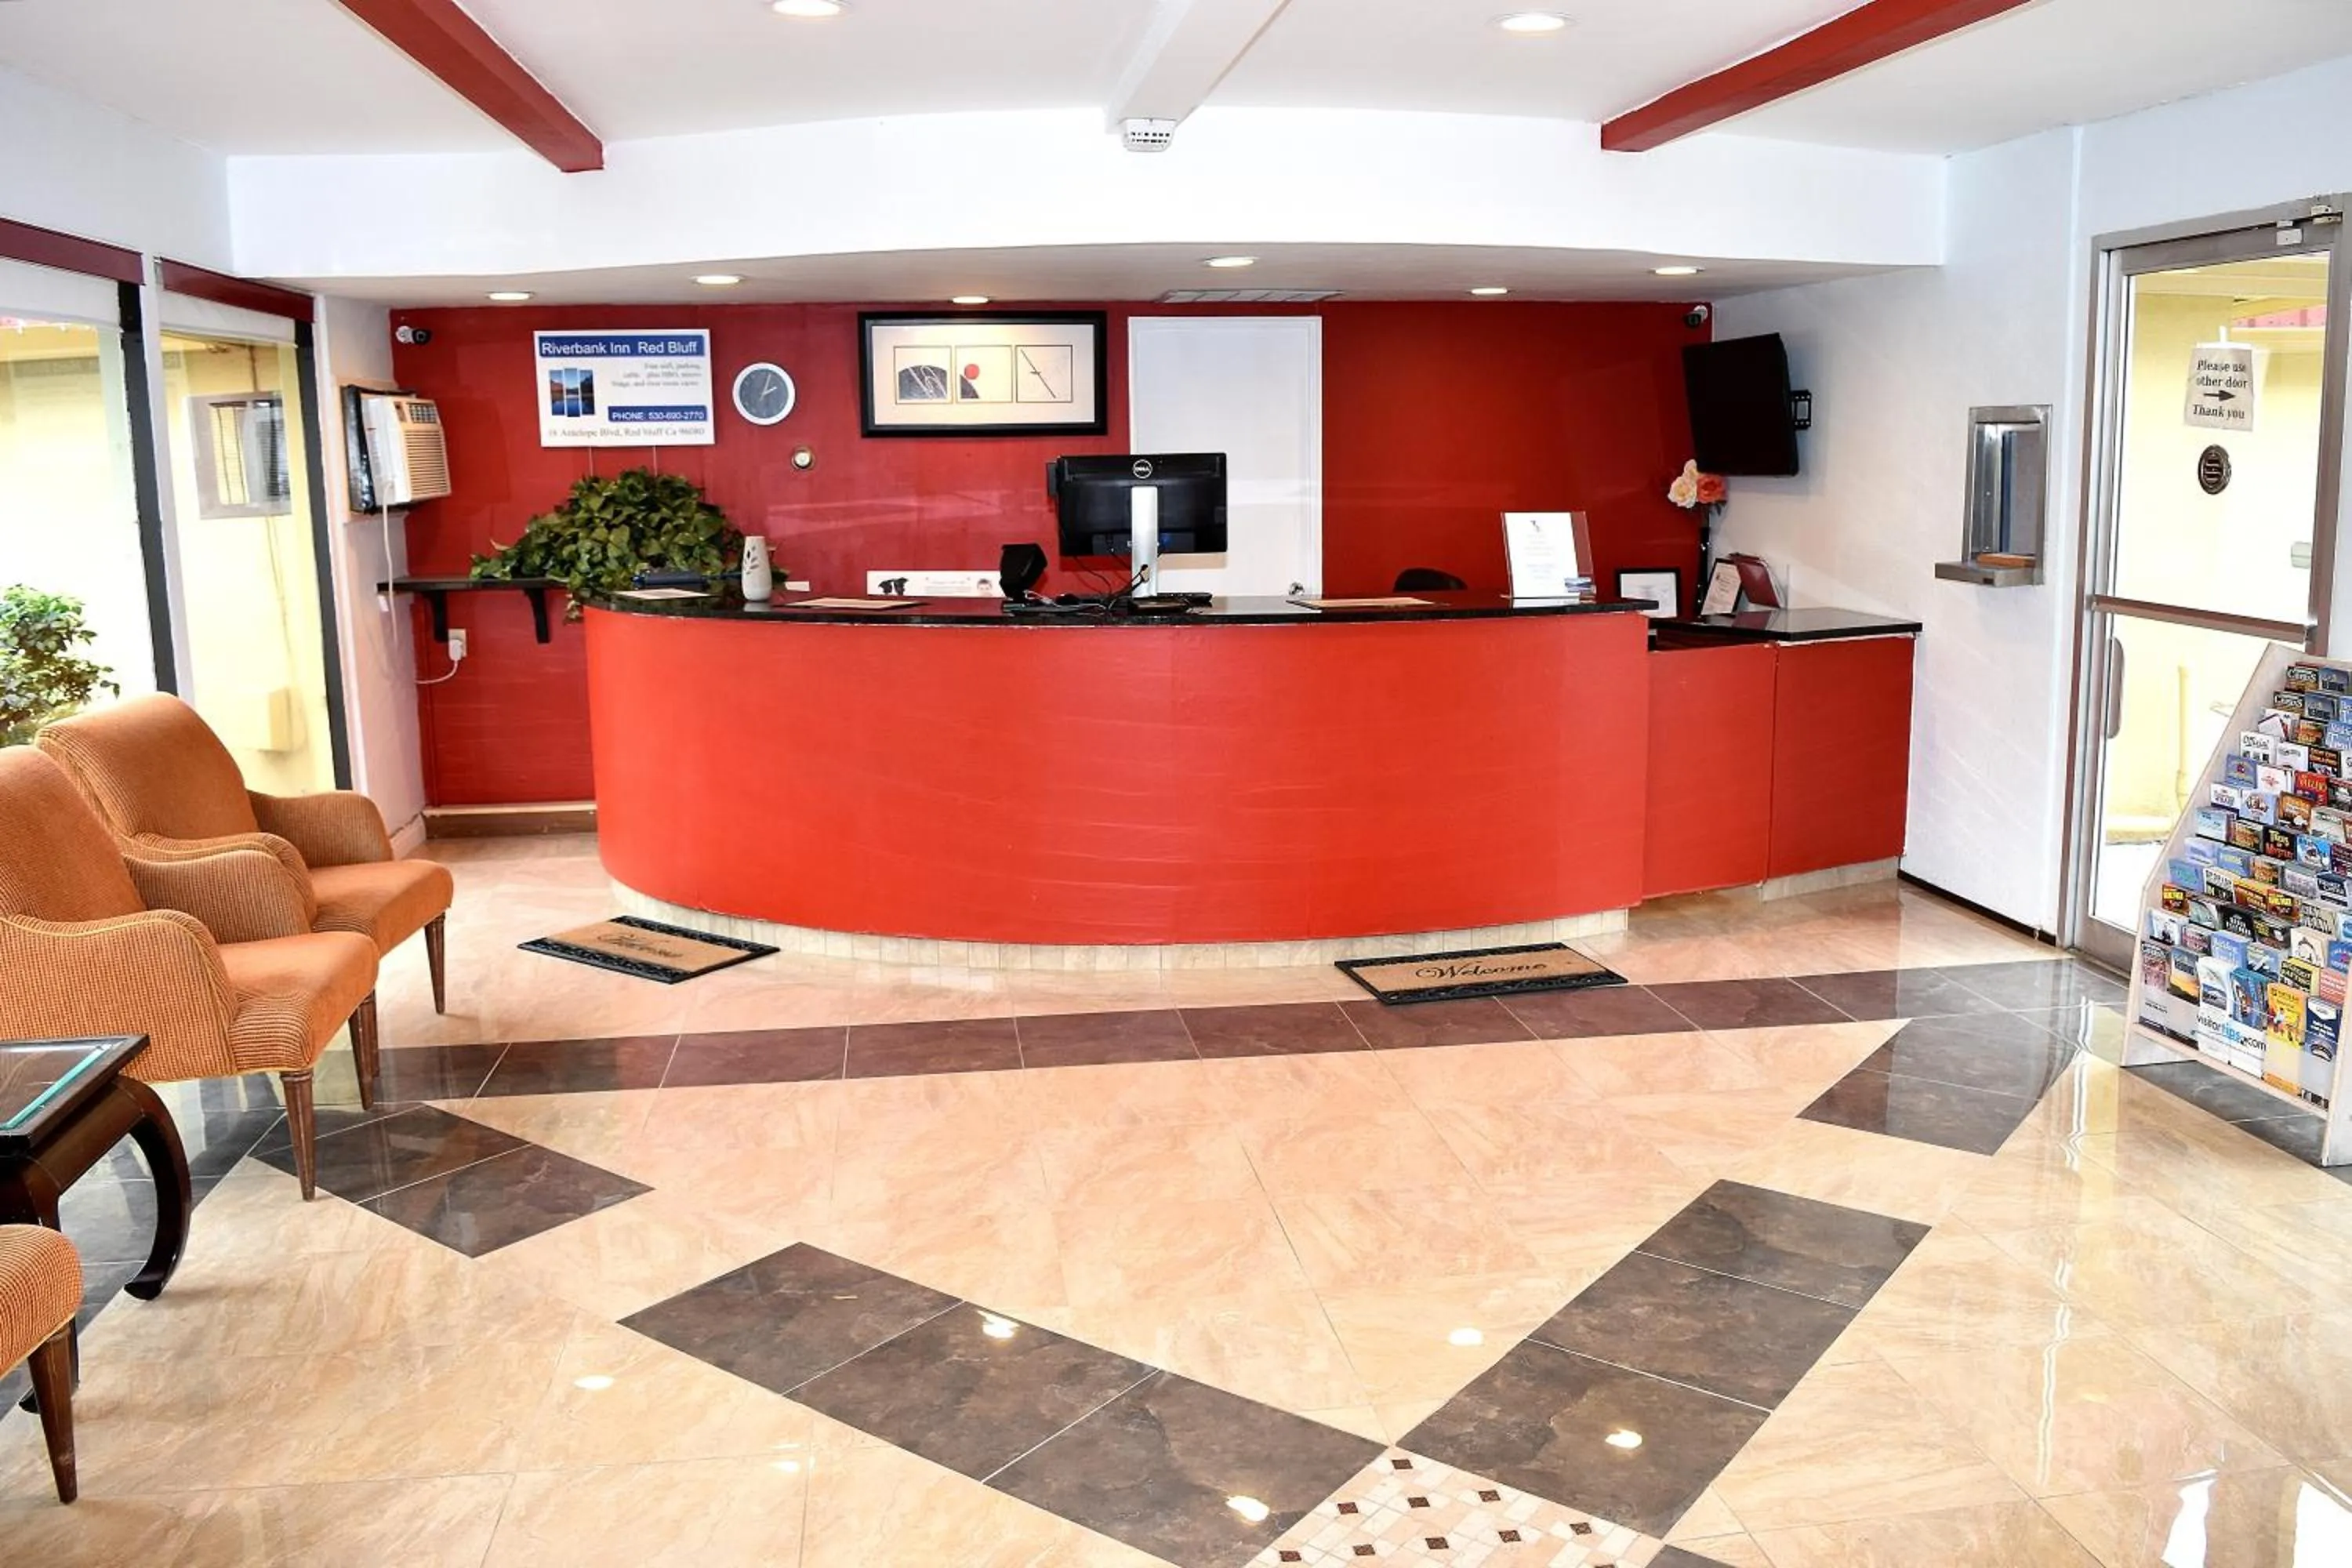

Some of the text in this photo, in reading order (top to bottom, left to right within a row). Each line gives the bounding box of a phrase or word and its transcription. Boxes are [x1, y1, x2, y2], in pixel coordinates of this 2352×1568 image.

[542, 340, 697, 354] Riverbank Inn Red Bluff
[2196, 359, 2246, 372] Please use
[2196, 376, 2248, 389] other door
[612, 412, 645, 421] PHONE:
[2193, 404, 2245, 420] Thank you
[1415, 961, 1548, 978] Welcome
